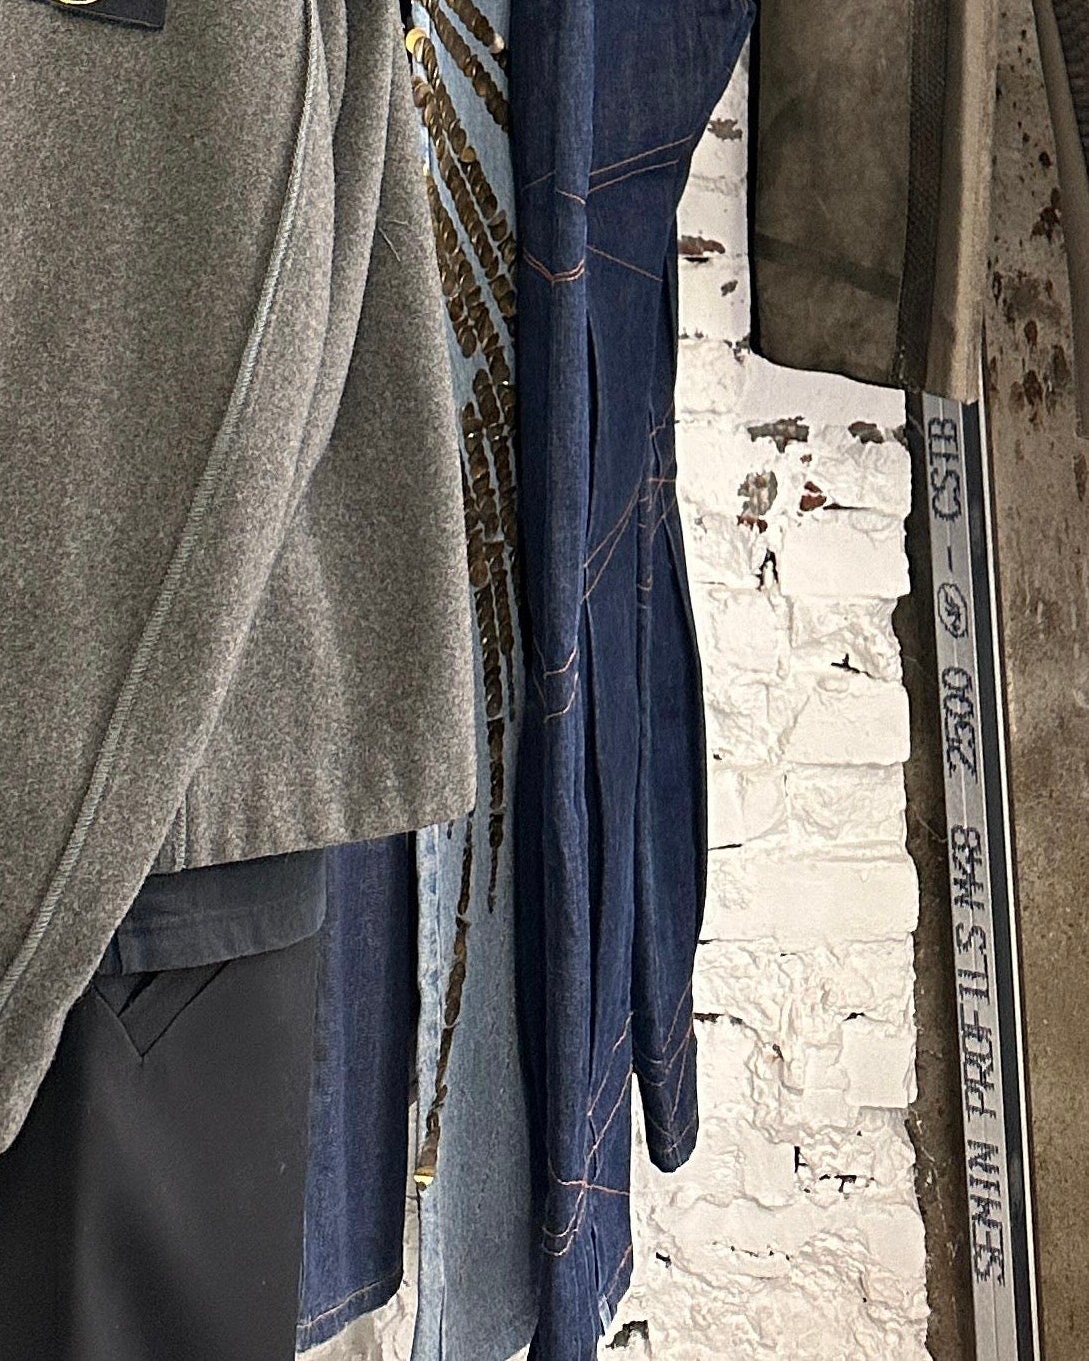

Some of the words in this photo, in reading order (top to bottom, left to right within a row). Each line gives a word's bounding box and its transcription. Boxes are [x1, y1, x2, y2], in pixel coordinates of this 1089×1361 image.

[928, 417, 962, 522] CSTB
[941, 666, 979, 785] 2500
[956, 922, 997, 1122] PROFILS
[967, 1139, 1007, 1288] SEMIN
